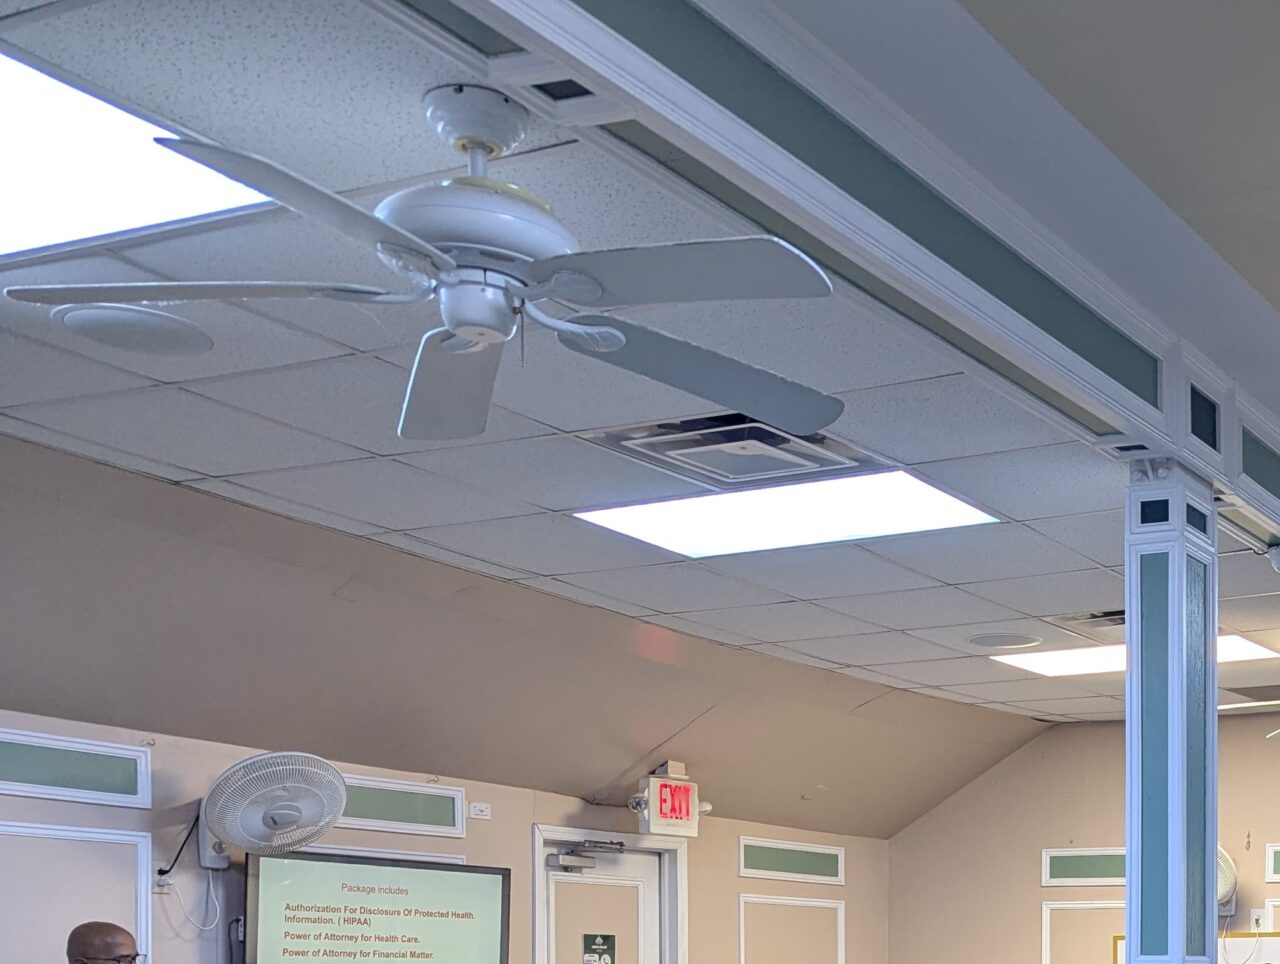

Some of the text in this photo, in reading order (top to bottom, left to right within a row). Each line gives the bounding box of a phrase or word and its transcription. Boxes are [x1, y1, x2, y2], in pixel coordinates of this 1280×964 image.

[659, 783, 691, 820] EXIT
[341, 883, 409, 896] Package includes
[284, 903, 476, 919] Authorization For Disclosure Of Protected Health.
[284, 915, 336, 925] Information.
[284, 931, 420, 943] Power of Attorney for Health Care.
[282, 948, 435, 959] Power of Attorney for Financial Matter.
